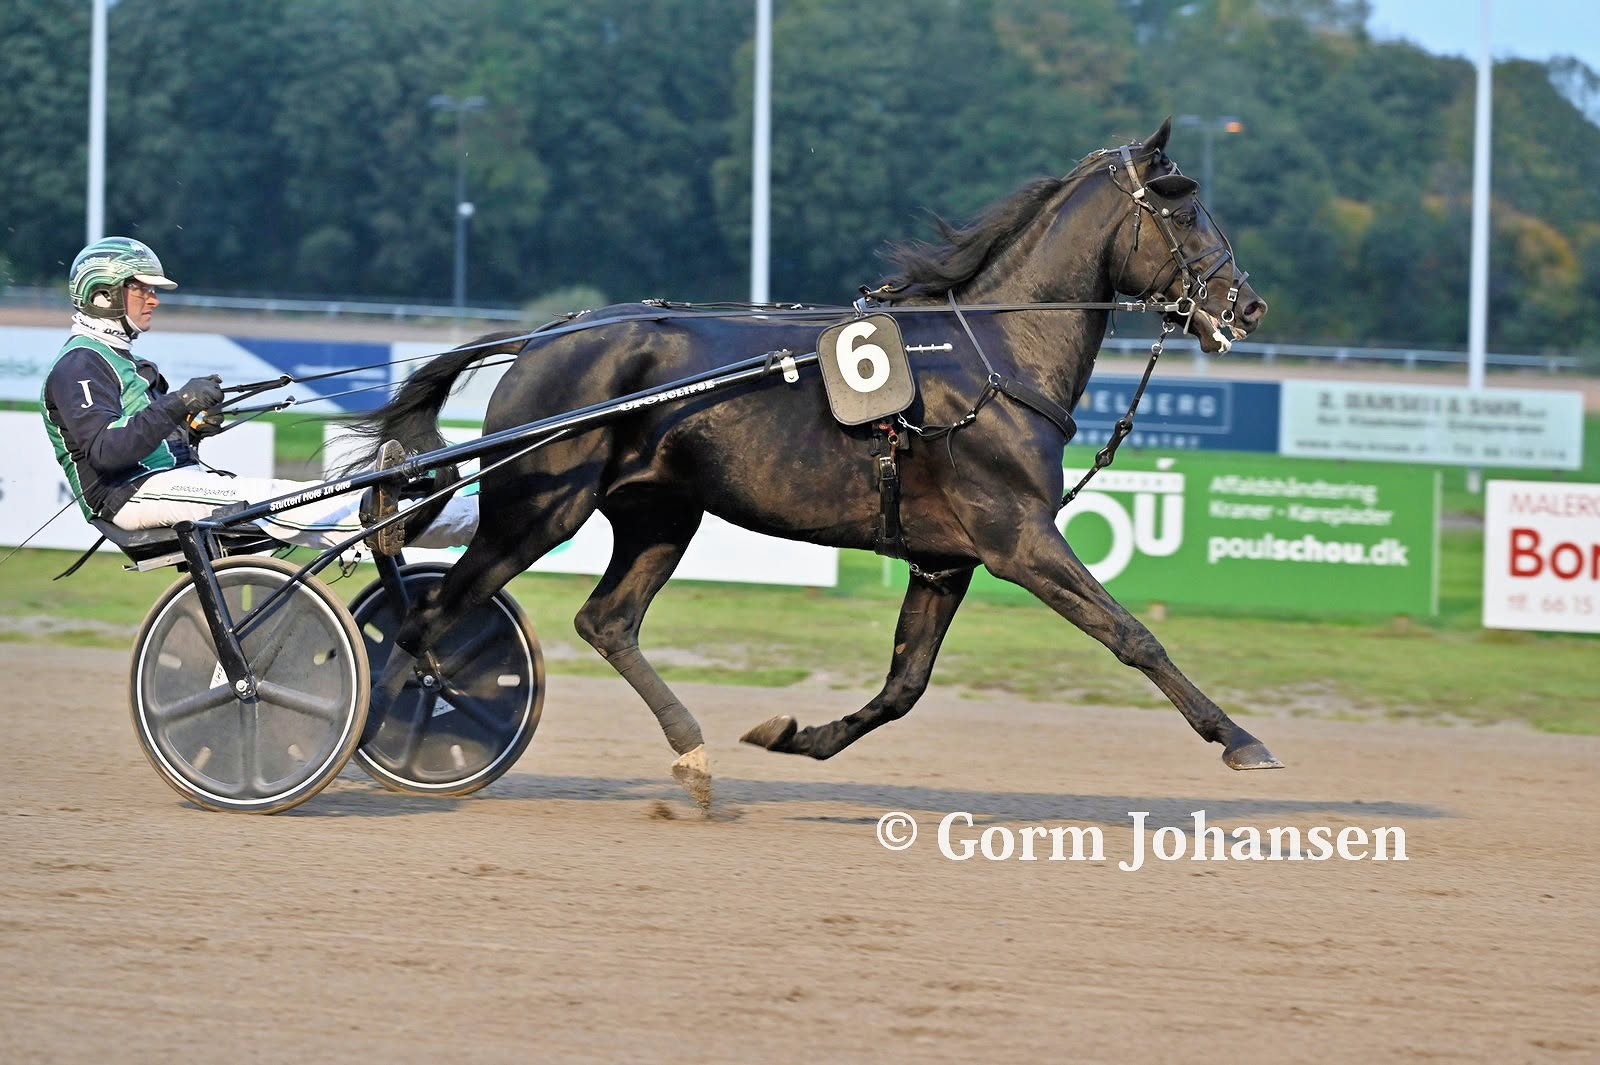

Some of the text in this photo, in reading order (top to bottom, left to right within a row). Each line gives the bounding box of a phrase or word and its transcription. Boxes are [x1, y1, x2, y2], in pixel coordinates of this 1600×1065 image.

[836, 321, 890, 393] 6
[77, 379, 94, 409] J
[1208, 533, 1409, 566] poulschou.dk
